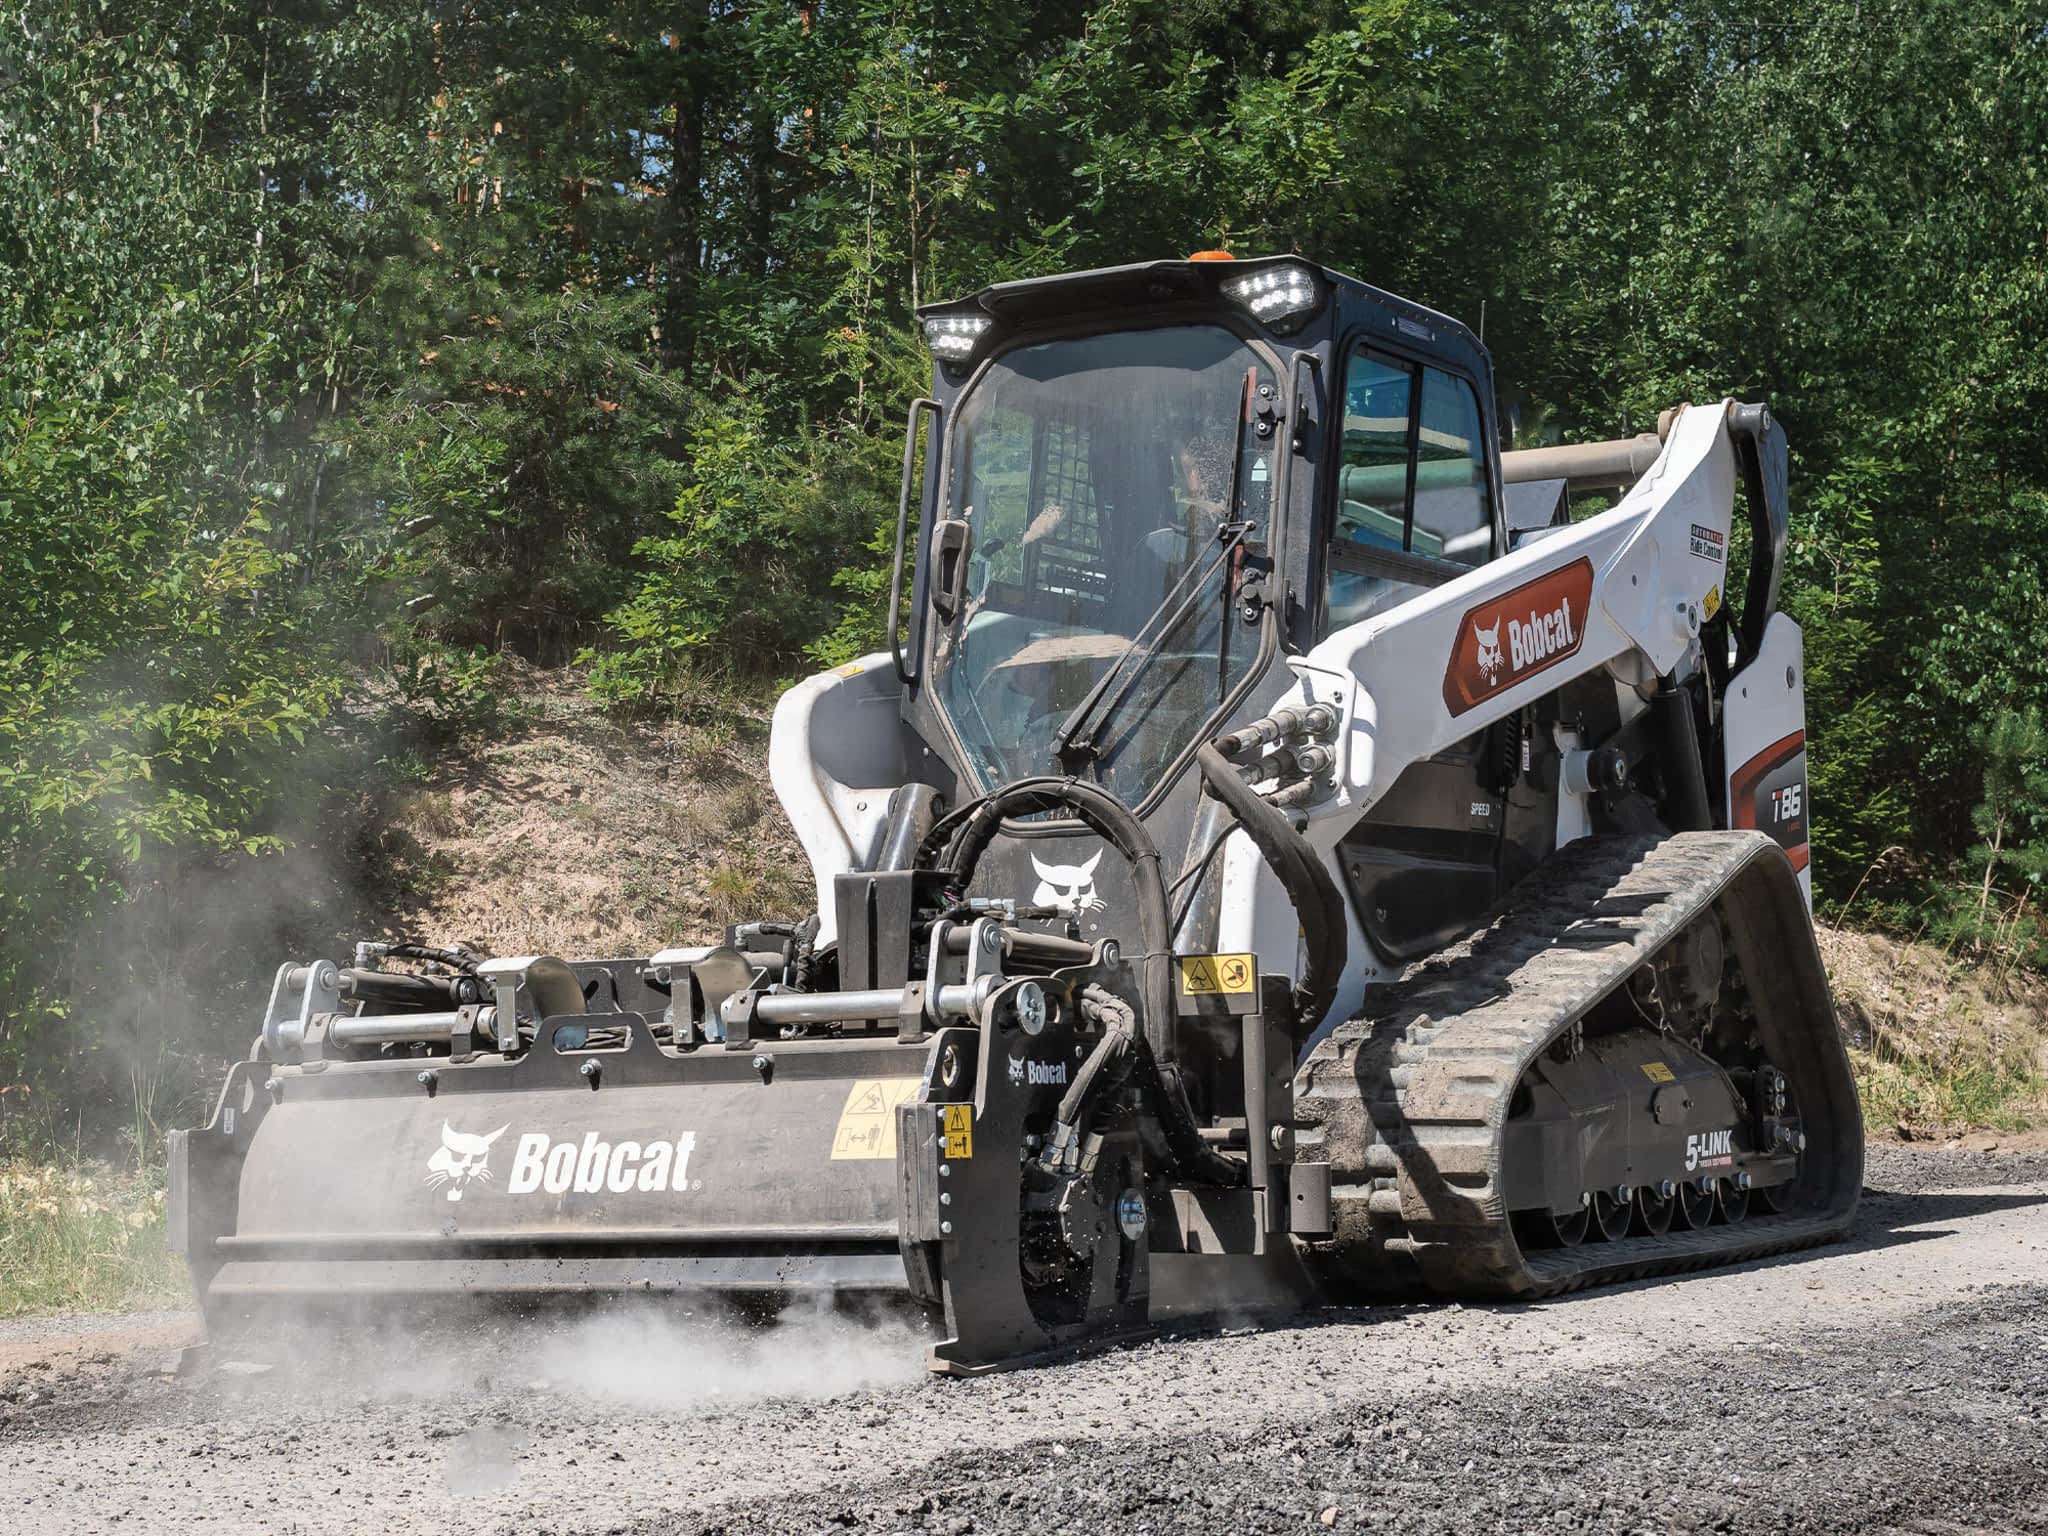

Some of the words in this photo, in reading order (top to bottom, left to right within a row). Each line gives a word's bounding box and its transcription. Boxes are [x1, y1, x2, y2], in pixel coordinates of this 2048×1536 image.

[1508, 597, 1573, 672] Bobcat
[1470, 802, 1490, 816] SPEED
[1027, 1060, 1067, 1084] Bobcat
[507, 1131, 696, 1194] Bobcat
[1685, 1129, 1732, 1171] 5-LINK
